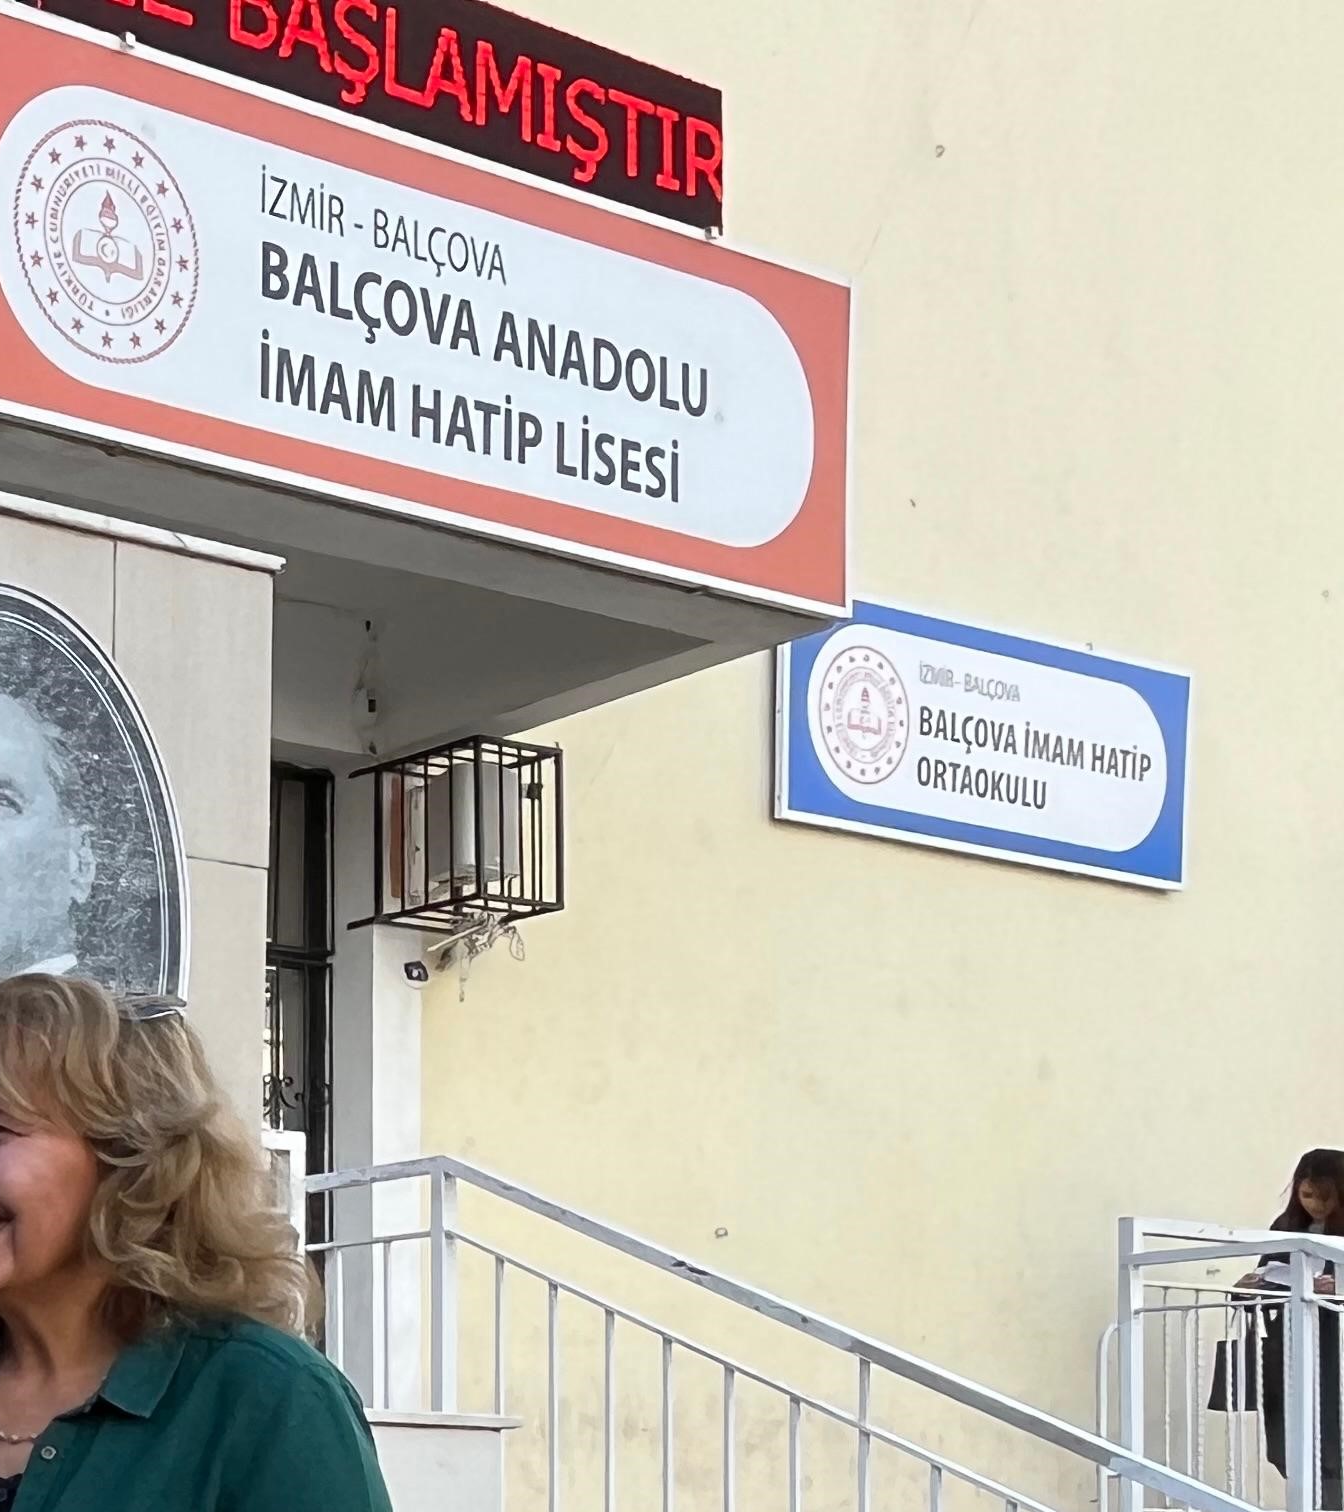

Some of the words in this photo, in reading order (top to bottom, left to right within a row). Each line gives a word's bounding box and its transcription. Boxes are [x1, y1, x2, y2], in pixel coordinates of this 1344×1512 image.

[261, 164, 345, 237] İZMİR
[373, 208, 507, 286] BALÇOVA
[261, 241, 480, 357] BALÇOVA
[493, 311, 709, 417] ANADOLU
[260, 328, 396, 432] İMAM
[411, 384, 543, 464] HATİP
[556, 415, 680, 502] LİSESİ
[964, 673, 1021, 702] BALÇOVA
[916, 756, 1047, 810] ORTAOKULU
[919, 705, 1018, 755] BALÇOVA
[1023, 720, 1085, 770] İMAM
[1090, 743, 1152, 783] HATİP
